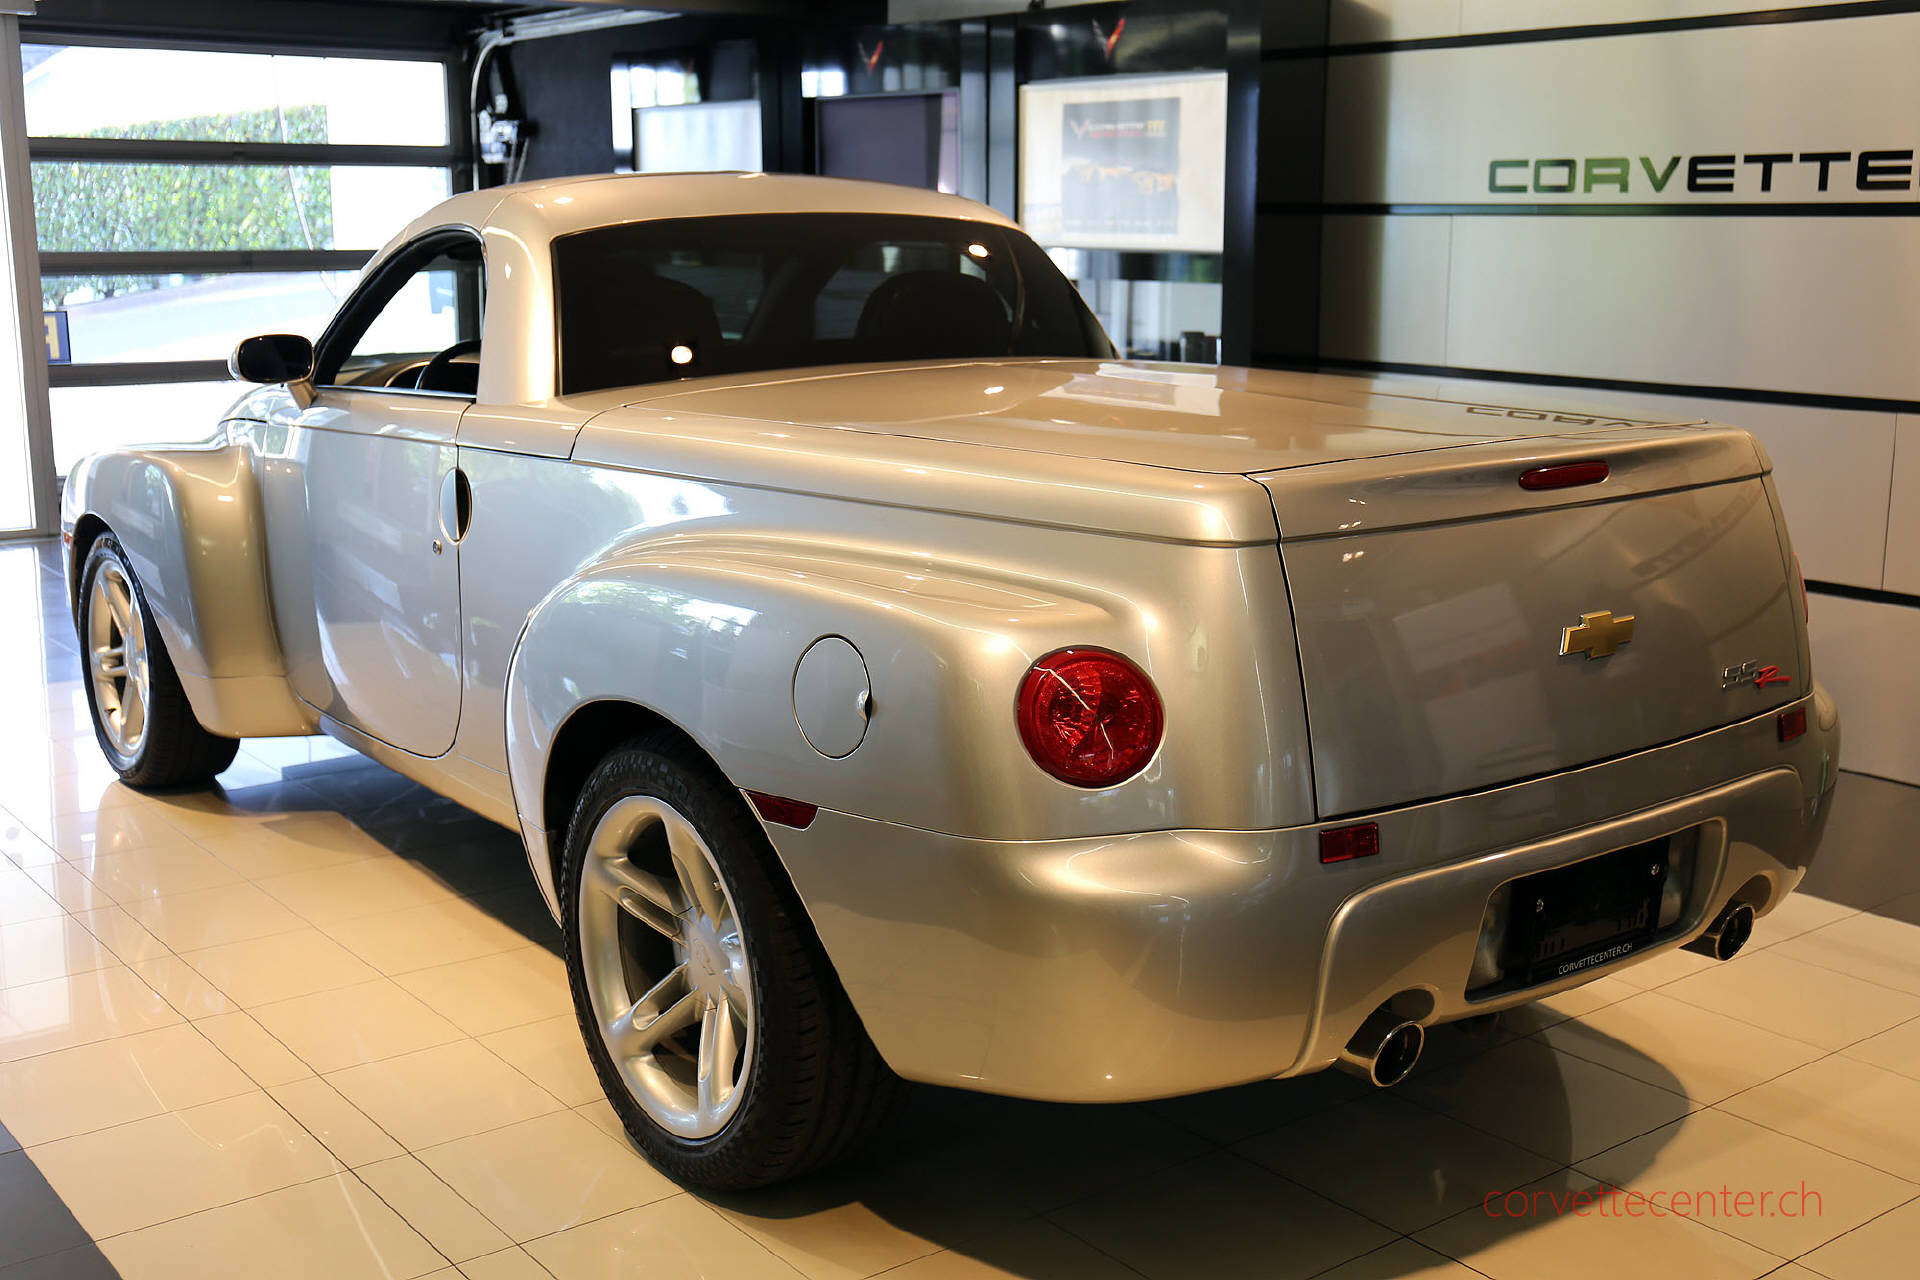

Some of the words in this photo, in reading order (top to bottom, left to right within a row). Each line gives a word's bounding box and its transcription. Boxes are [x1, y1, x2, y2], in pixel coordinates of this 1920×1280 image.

[1489, 150, 1920, 193] CORVETTE
[1721, 659, 1792, 688] SSR
[1558, 942, 1633, 975] CORVETTECENTER.CH
